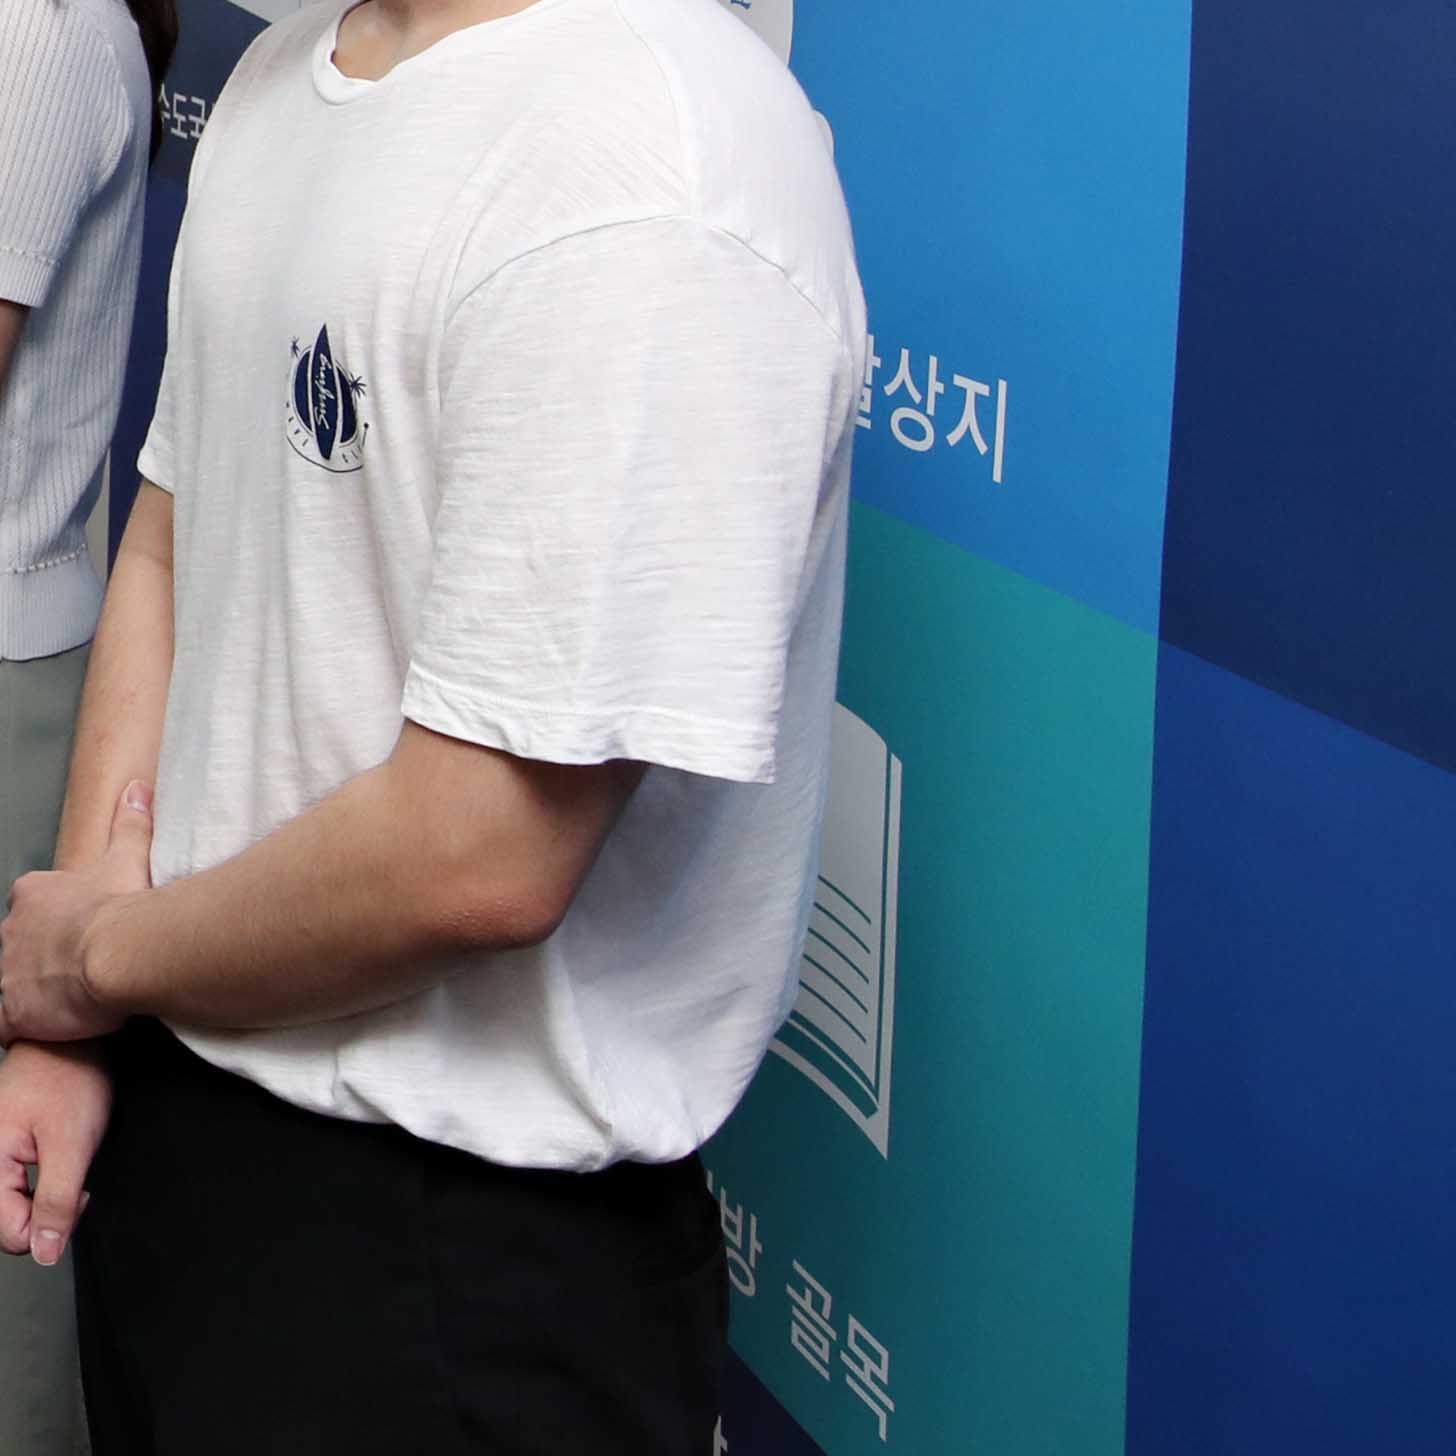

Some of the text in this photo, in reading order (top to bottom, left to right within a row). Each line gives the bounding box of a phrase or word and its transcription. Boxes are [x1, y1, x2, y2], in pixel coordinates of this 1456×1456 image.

[158, 82, 217, 140] 수도국
[707, 1169, 897, 1444] 방 골목
